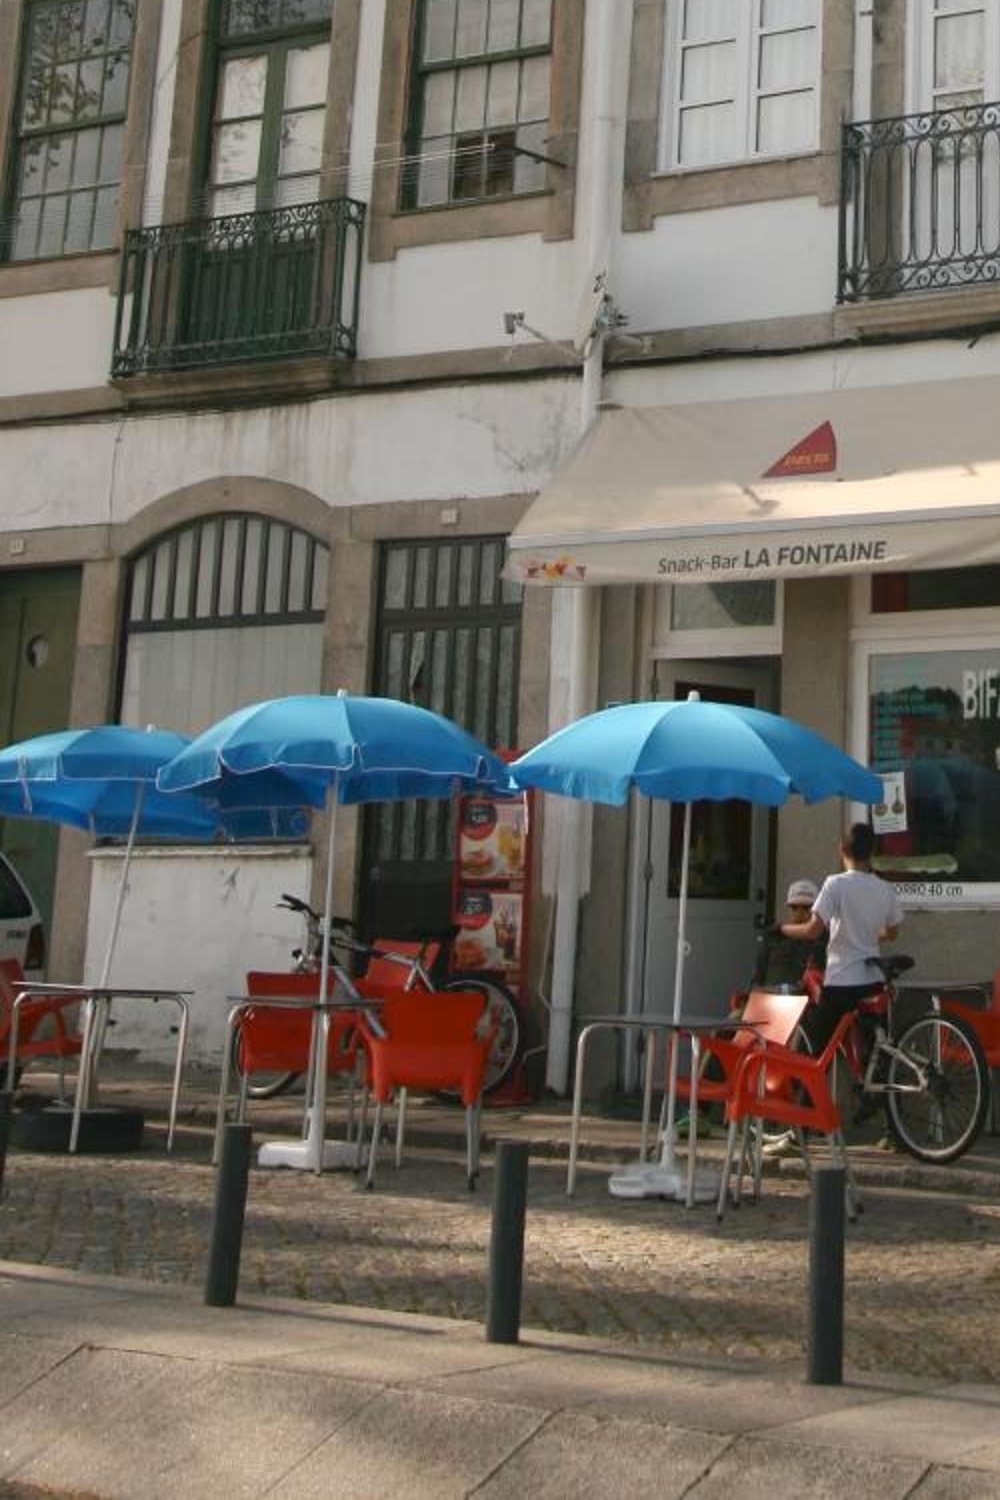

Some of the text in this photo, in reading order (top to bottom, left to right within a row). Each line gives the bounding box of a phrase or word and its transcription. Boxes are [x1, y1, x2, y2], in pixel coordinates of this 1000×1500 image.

[657, 541, 887, 574] Snack-Bar LA FONTAINE
[927, 883, 943, 896] 40
[945, 884, 963, 897] cm
